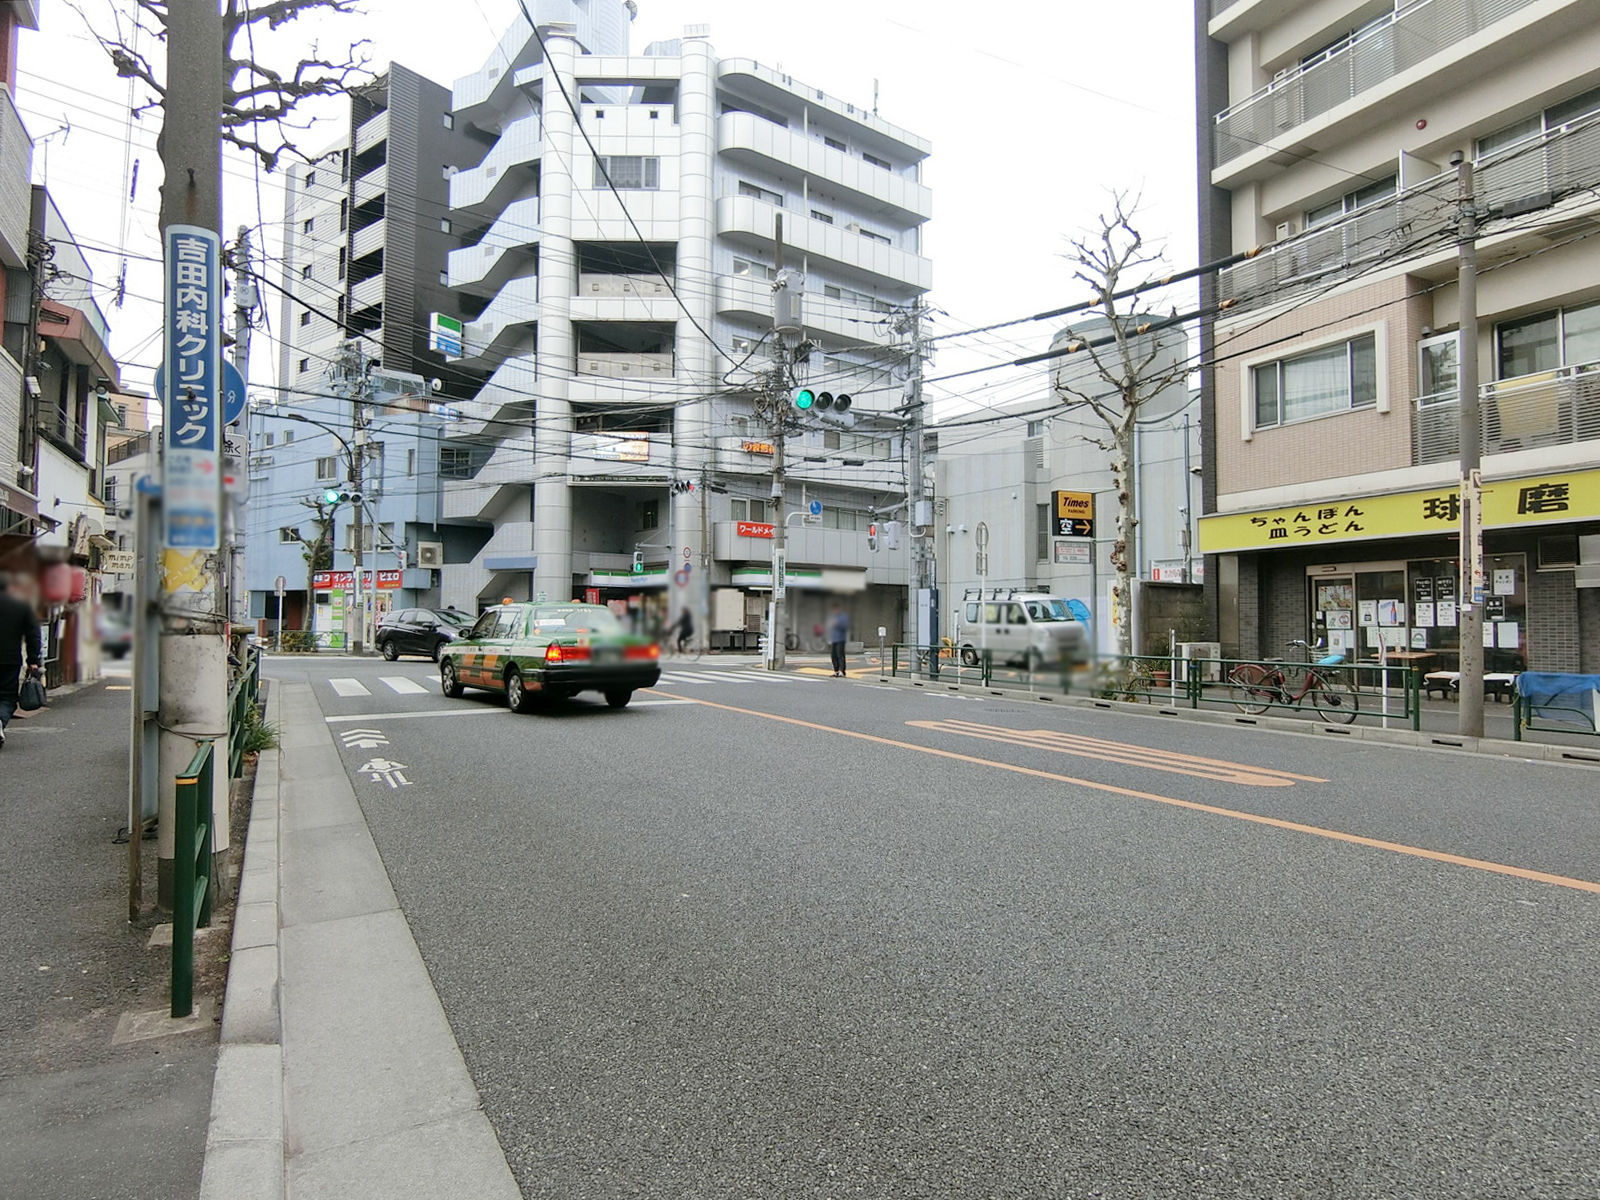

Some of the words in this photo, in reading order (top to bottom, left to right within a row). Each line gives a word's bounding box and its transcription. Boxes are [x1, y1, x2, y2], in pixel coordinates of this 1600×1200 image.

[176, 237, 209, 445] 吉田内科クリニック
[228, 390, 236, 404] 分
[1063, 496, 1089, 508] Times
[1250, 505, 1364, 528] ちゃんぽん
[1060, 519, 1073, 535] 空
[1268, 520, 1365, 540] 皿うどん
[379, 572, 400, 581] ピエロ
